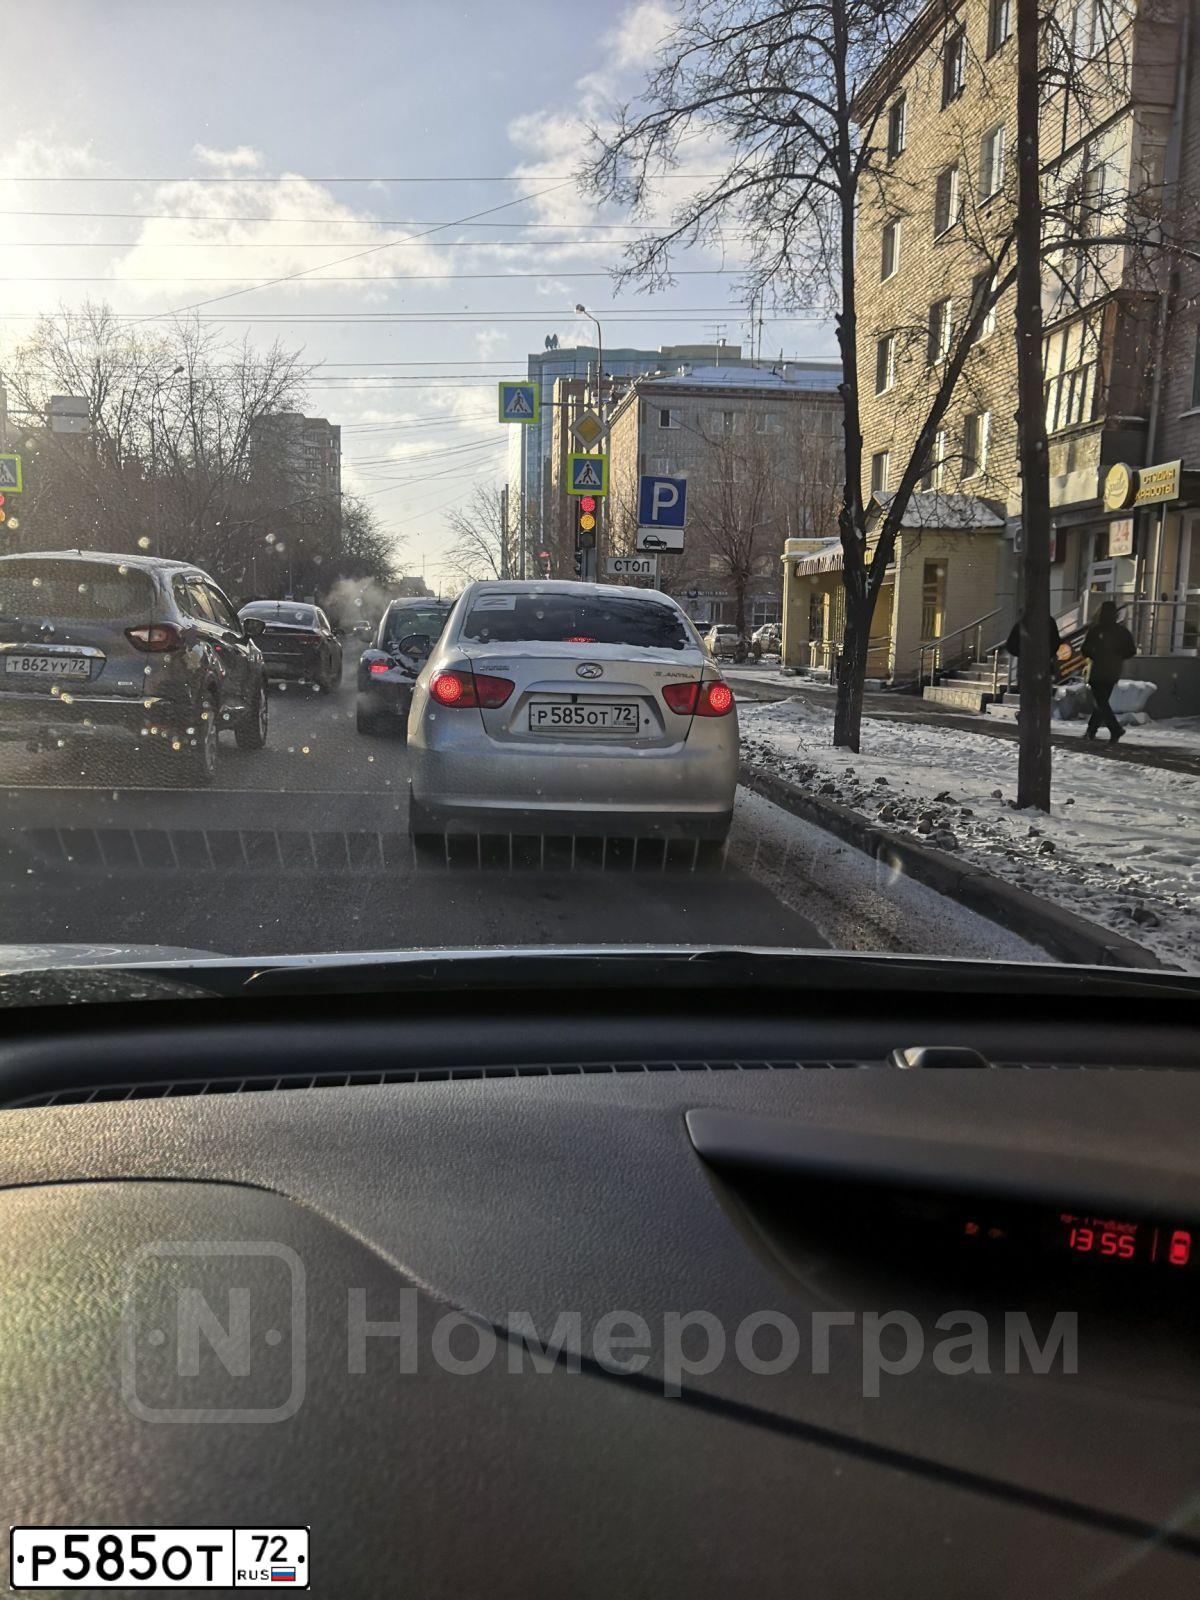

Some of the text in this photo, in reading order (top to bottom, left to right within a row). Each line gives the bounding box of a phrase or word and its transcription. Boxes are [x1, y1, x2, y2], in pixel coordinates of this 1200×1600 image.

[614, 560, 650, 573] СТОП
[11, 658, 86, 673] Т862УУ 72
[537, 706, 632, 725] Р585ОТ 72
